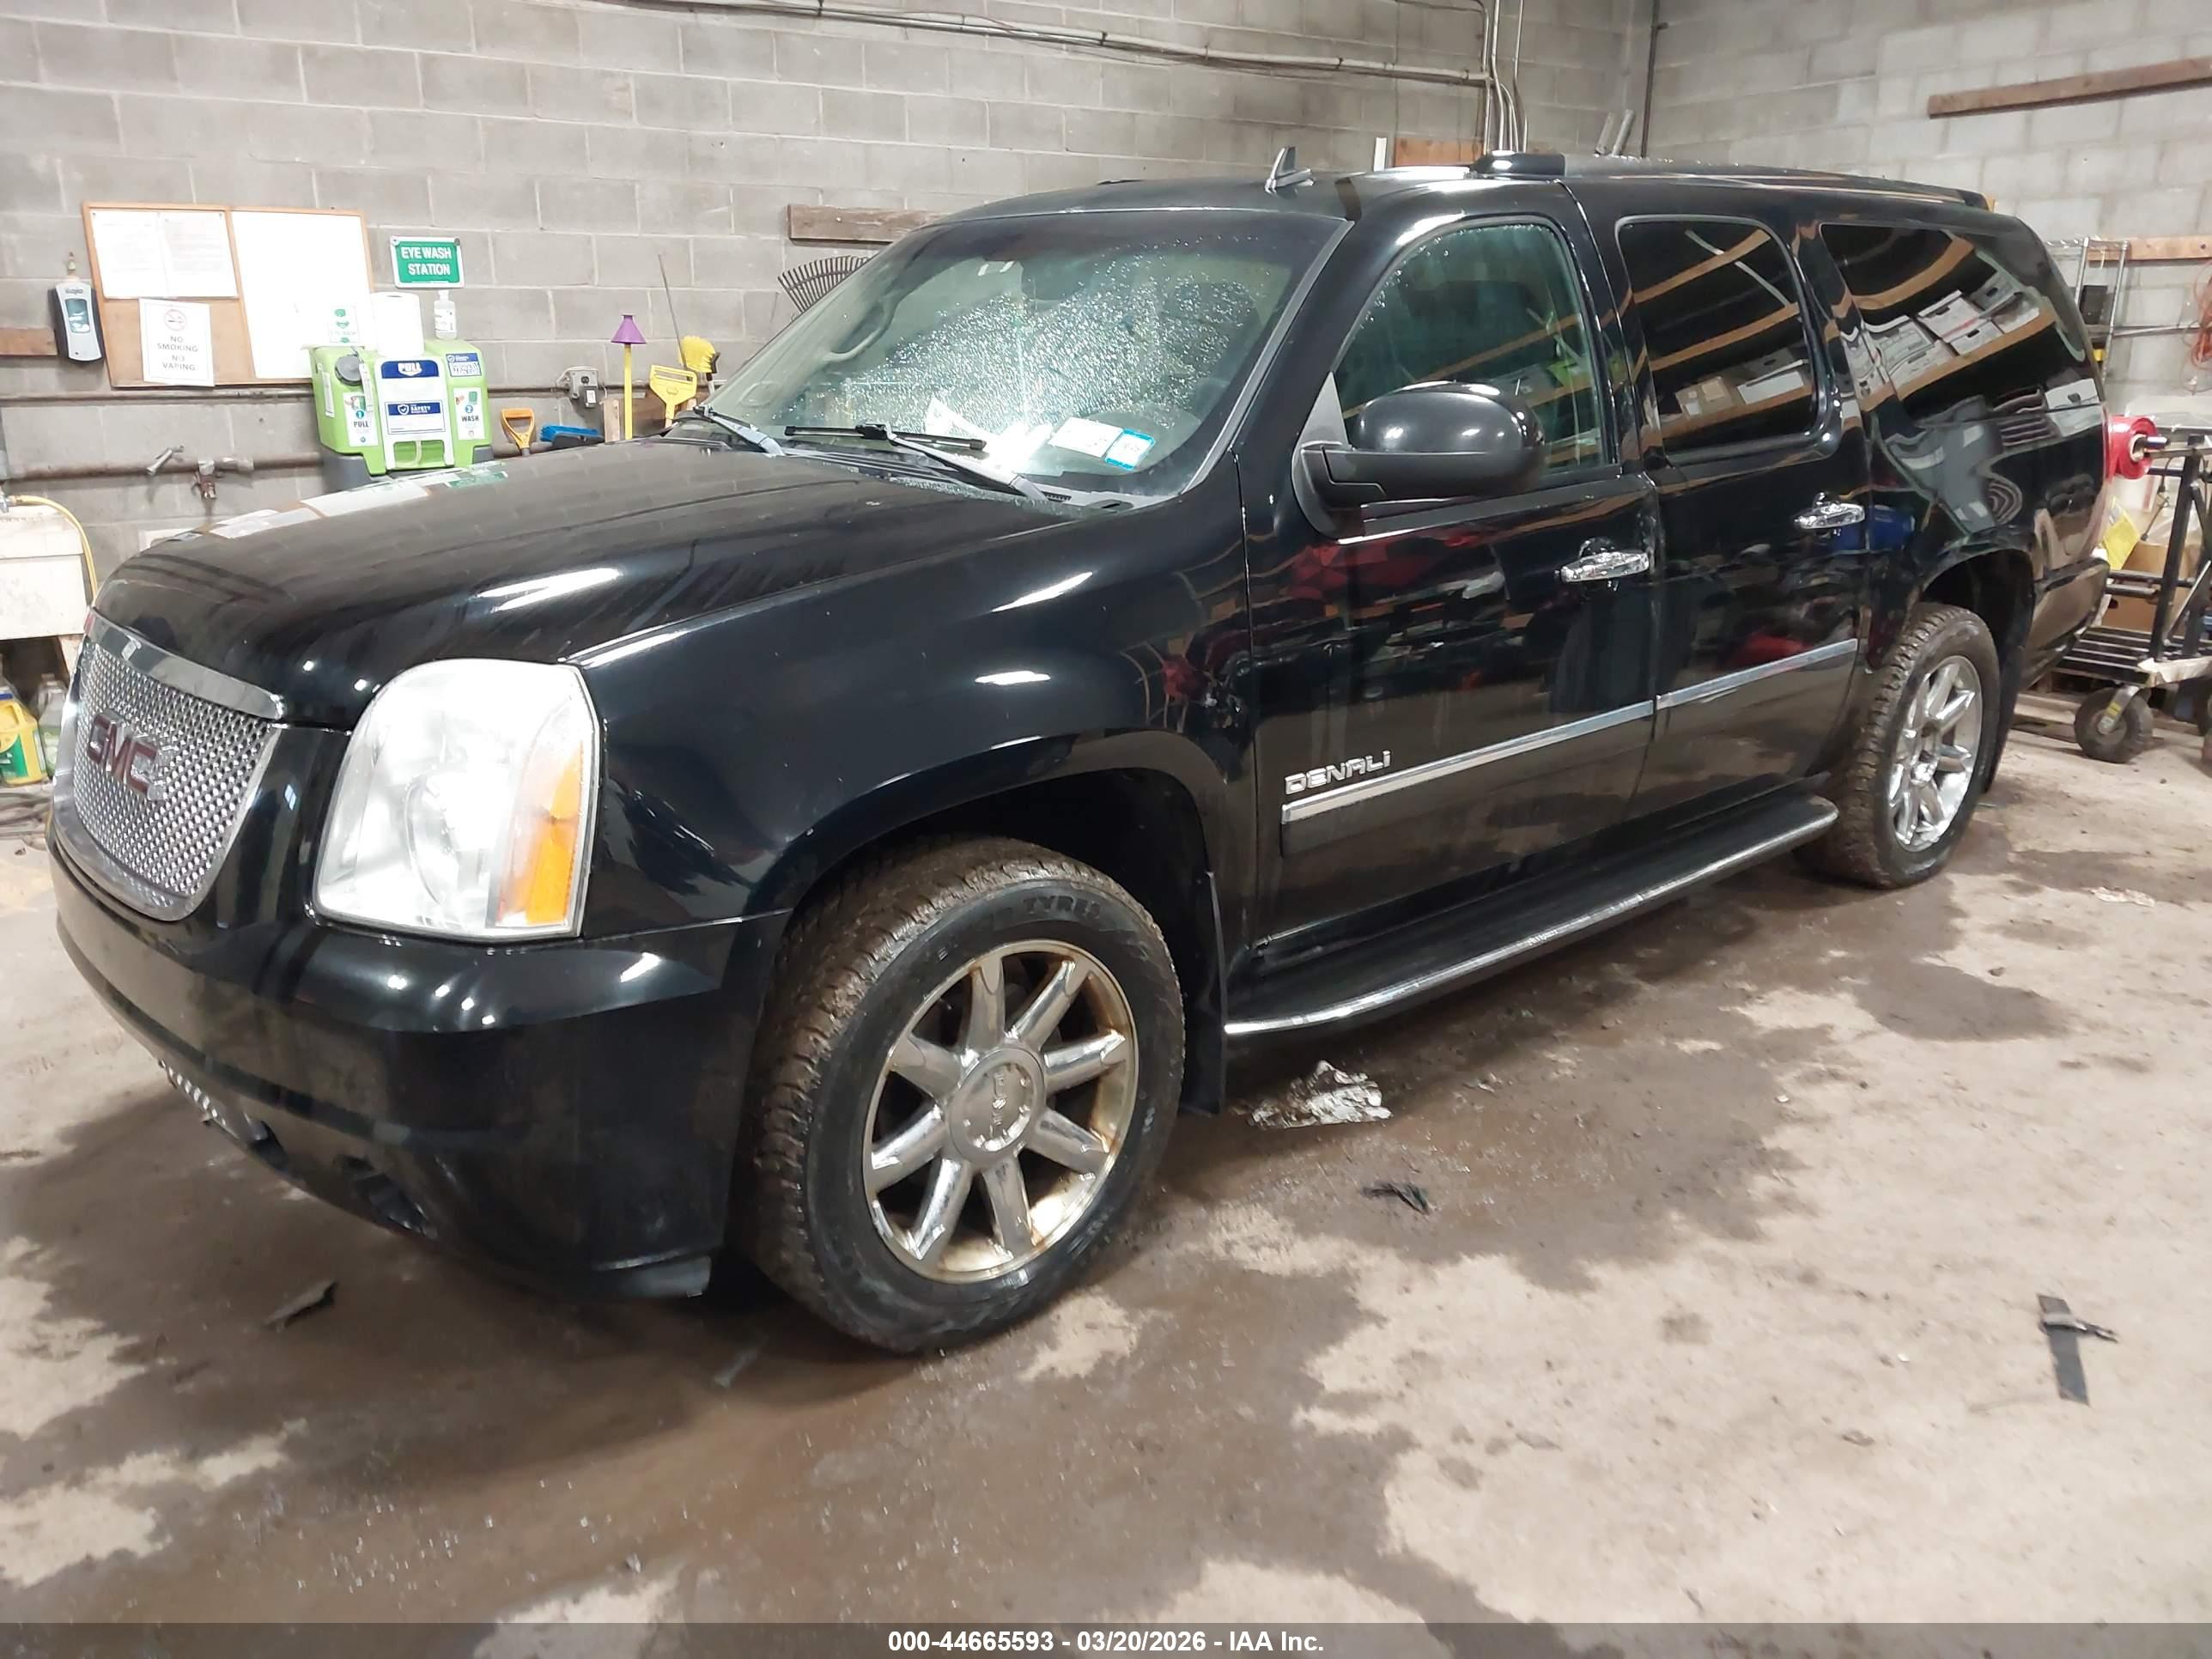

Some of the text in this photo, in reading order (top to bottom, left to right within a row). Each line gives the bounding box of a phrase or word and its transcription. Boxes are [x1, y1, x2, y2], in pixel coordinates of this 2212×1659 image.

[400, 246, 453, 259] EYE WASH
[408, 263, 451, 276] STATION
[157, 343, 199, 352] SMOKING
[162, 362, 196, 371] VAPING
[87, 713, 159, 796] GMC
[1284, 749, 1391, 795] DENALI
